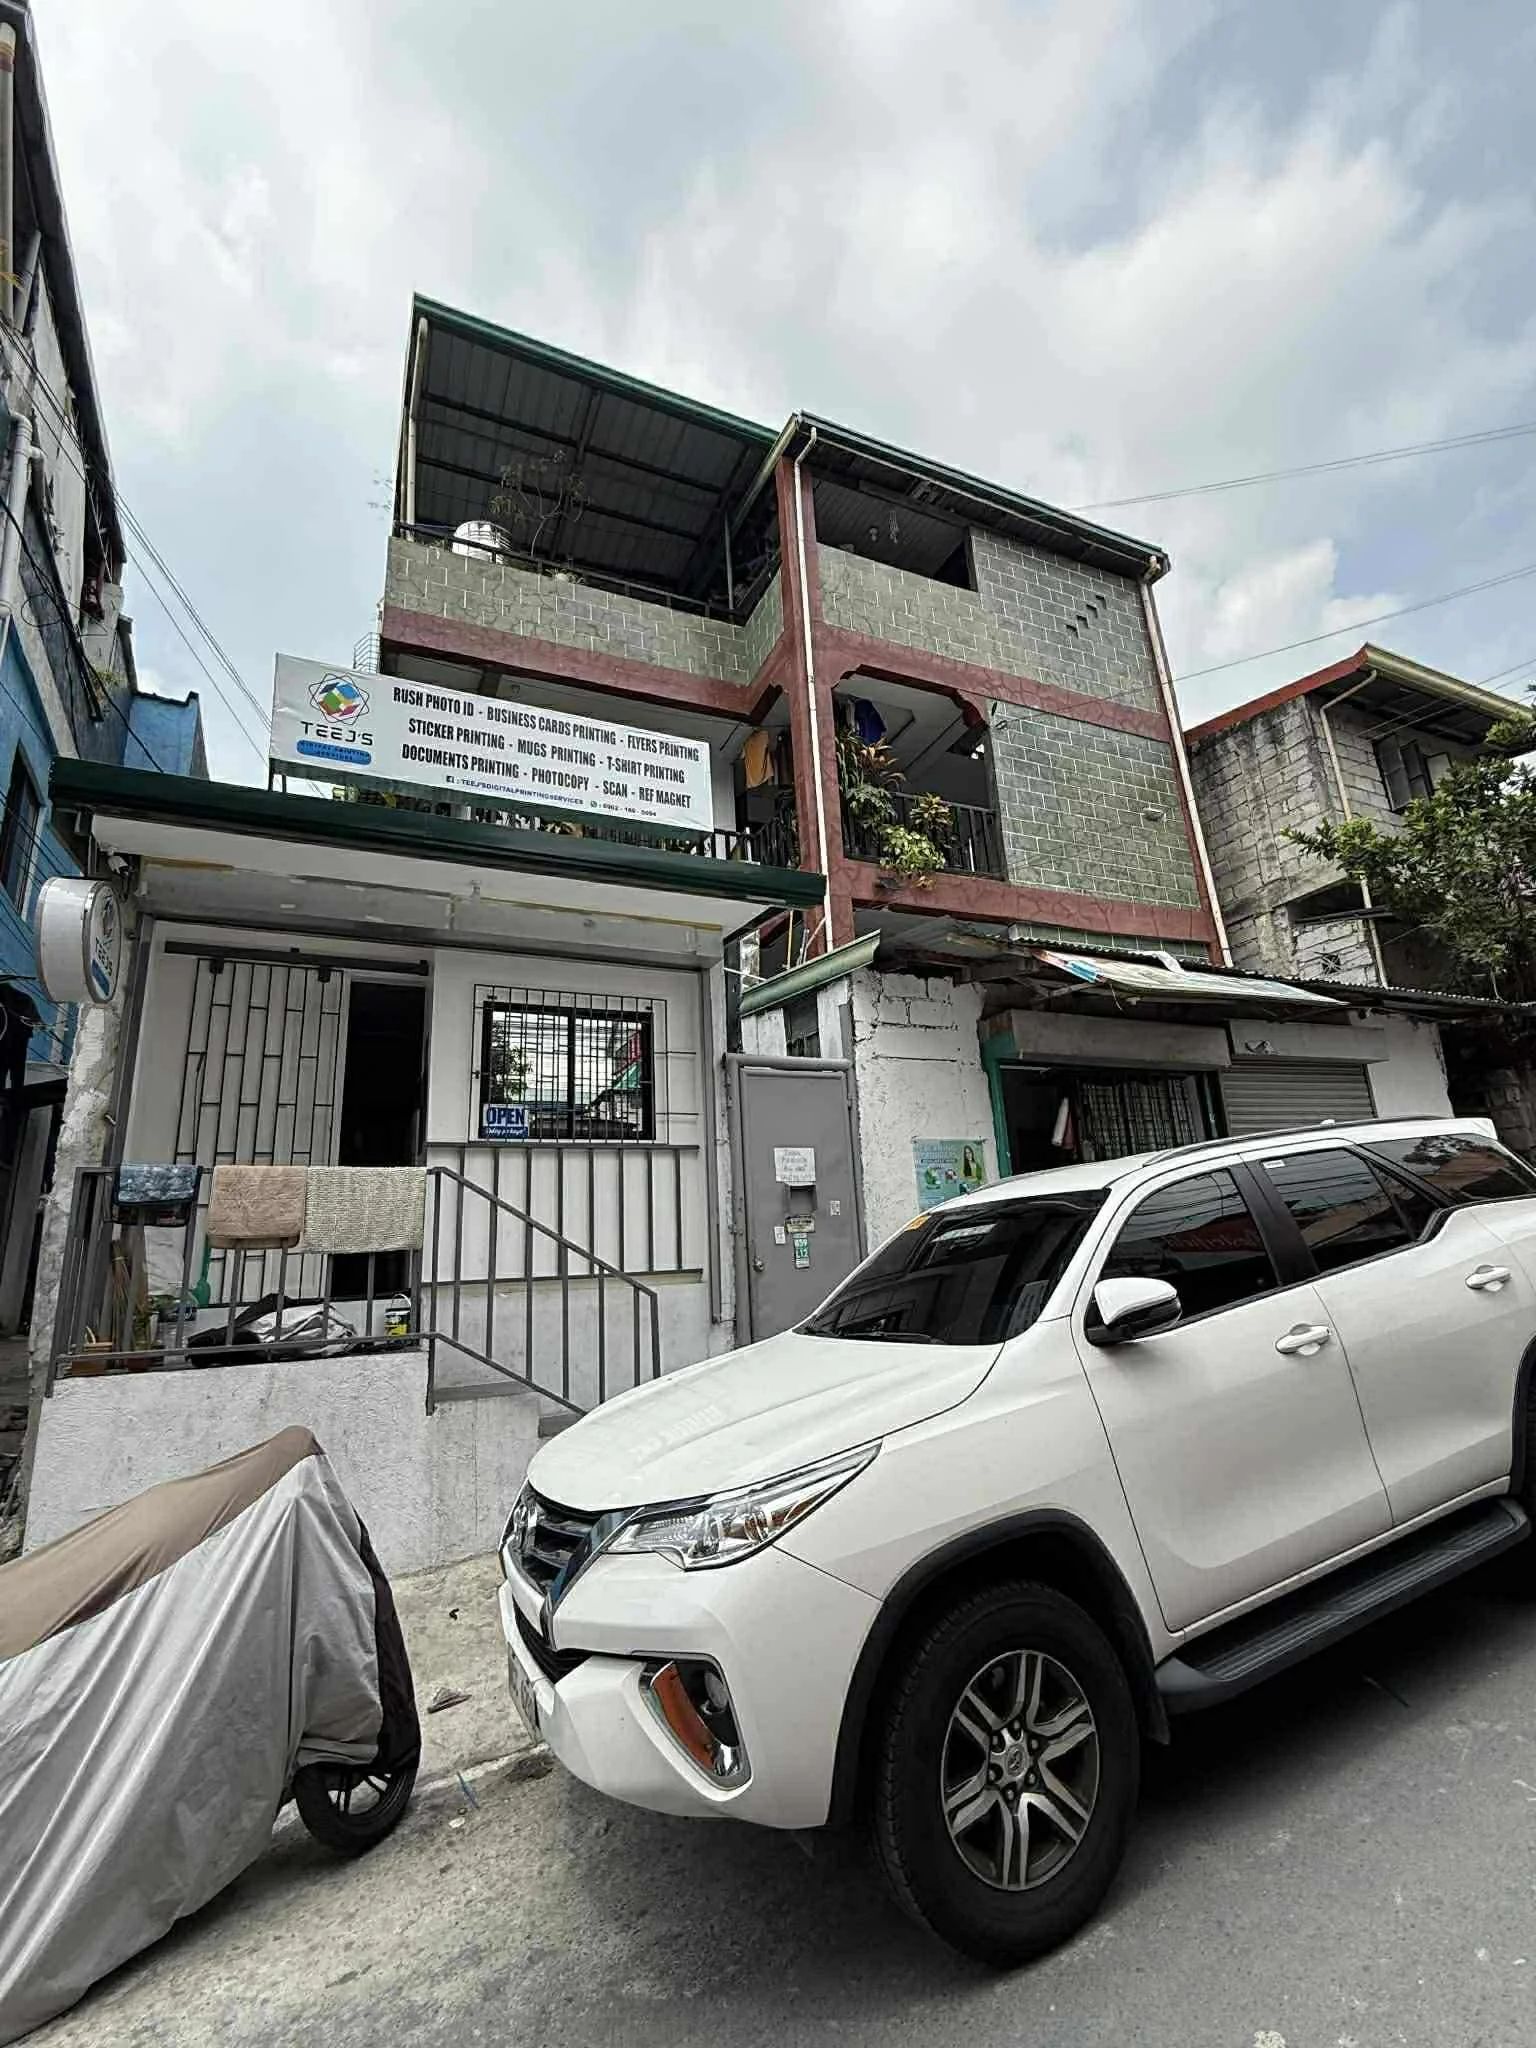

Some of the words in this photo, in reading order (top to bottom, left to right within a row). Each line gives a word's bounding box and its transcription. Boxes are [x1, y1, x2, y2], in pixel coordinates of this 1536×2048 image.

[300, 720, 374, 746] TEEJ'S
[393, 686, 423, 707] RUSH
[426, 693, 461, 714] PHOTO
[463, 701, 474, 717] ID
[487, 706, 537, 730] BUSINESS
[539, 716, 571, 737] CARDS
[573, 724, 617, 746] PRINTING
[627, 734, 658, 754] FLYERS
[659, 741, 700, 762] PRINTING
[408, 718, 454, 741] STICKER
[456, 727, 505, 750] PRINTING
[517, 738, 547, 758] MUGS
[551, 745, 596, 767] PRINTING
[607, 755, 642, 776] T-SHIRT
[643, 763, 685, 784] PRINTING
[402, 743, 469, 770] DOCUMENTS
[471, 756, 520, 779] PRINTING
[532, 767, 590, 791] PHOTOCOPY
[602, 780, 628, 798] SCAN
[639, 786, 655, 802] REF
[656, 790, 692, 809] MAGNET
[486, 1106, 525, 1125] OPEN
